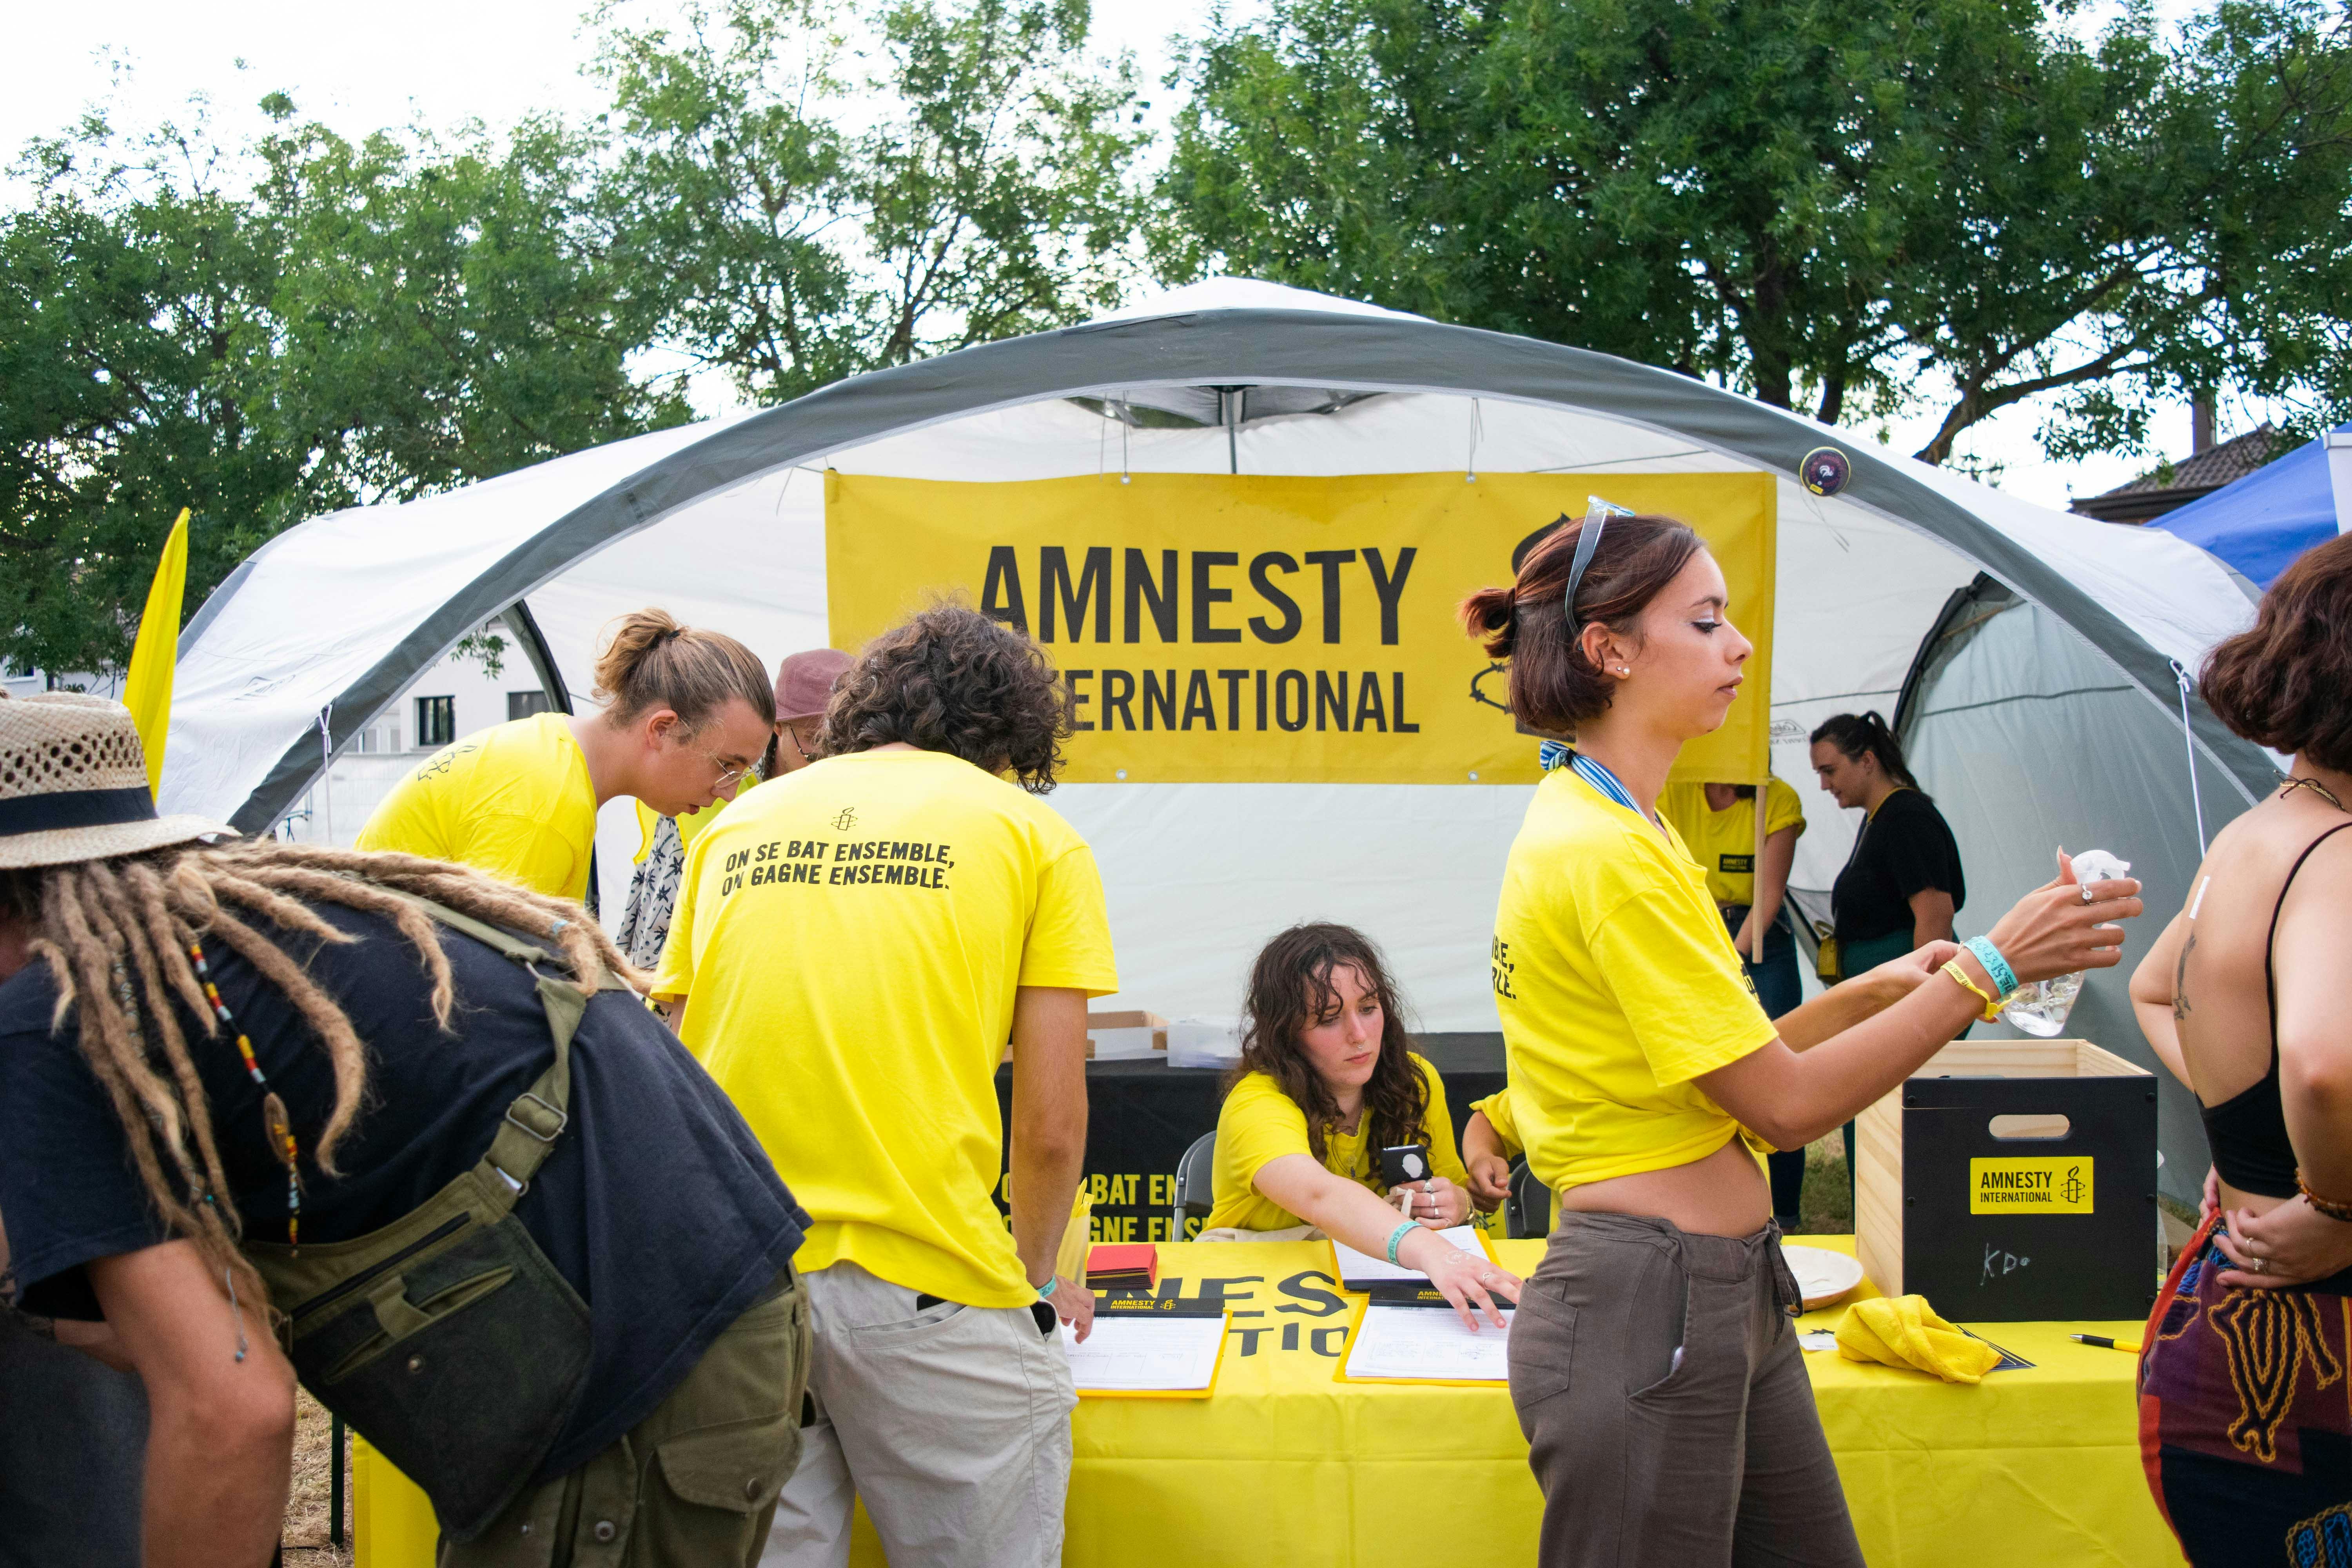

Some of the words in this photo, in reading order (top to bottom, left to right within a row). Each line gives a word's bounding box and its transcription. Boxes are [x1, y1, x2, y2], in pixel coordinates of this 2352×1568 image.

[980, 546, 1418, 645] AMNESTY
[1051, 669, 1420, 733] ERNATIONAL
[726, 848, 750, 872] ON
[755, 841, 781, 862] SE
[787, 840, 829, 858] BAT
[834, 841, 955, 868] ENSEMBLE,
[722, 871, 745, 896] ON
[751, 863, 822, 886] GAGNE
[829, 864, 950, 889] ENSEMBLE.
[1091, 1174, 1140, 1205] BAT
[1980, 1171, 2053, 1188] AMNESTY
[1980, 1192, 2053, 1202] INTERNATIONAL
